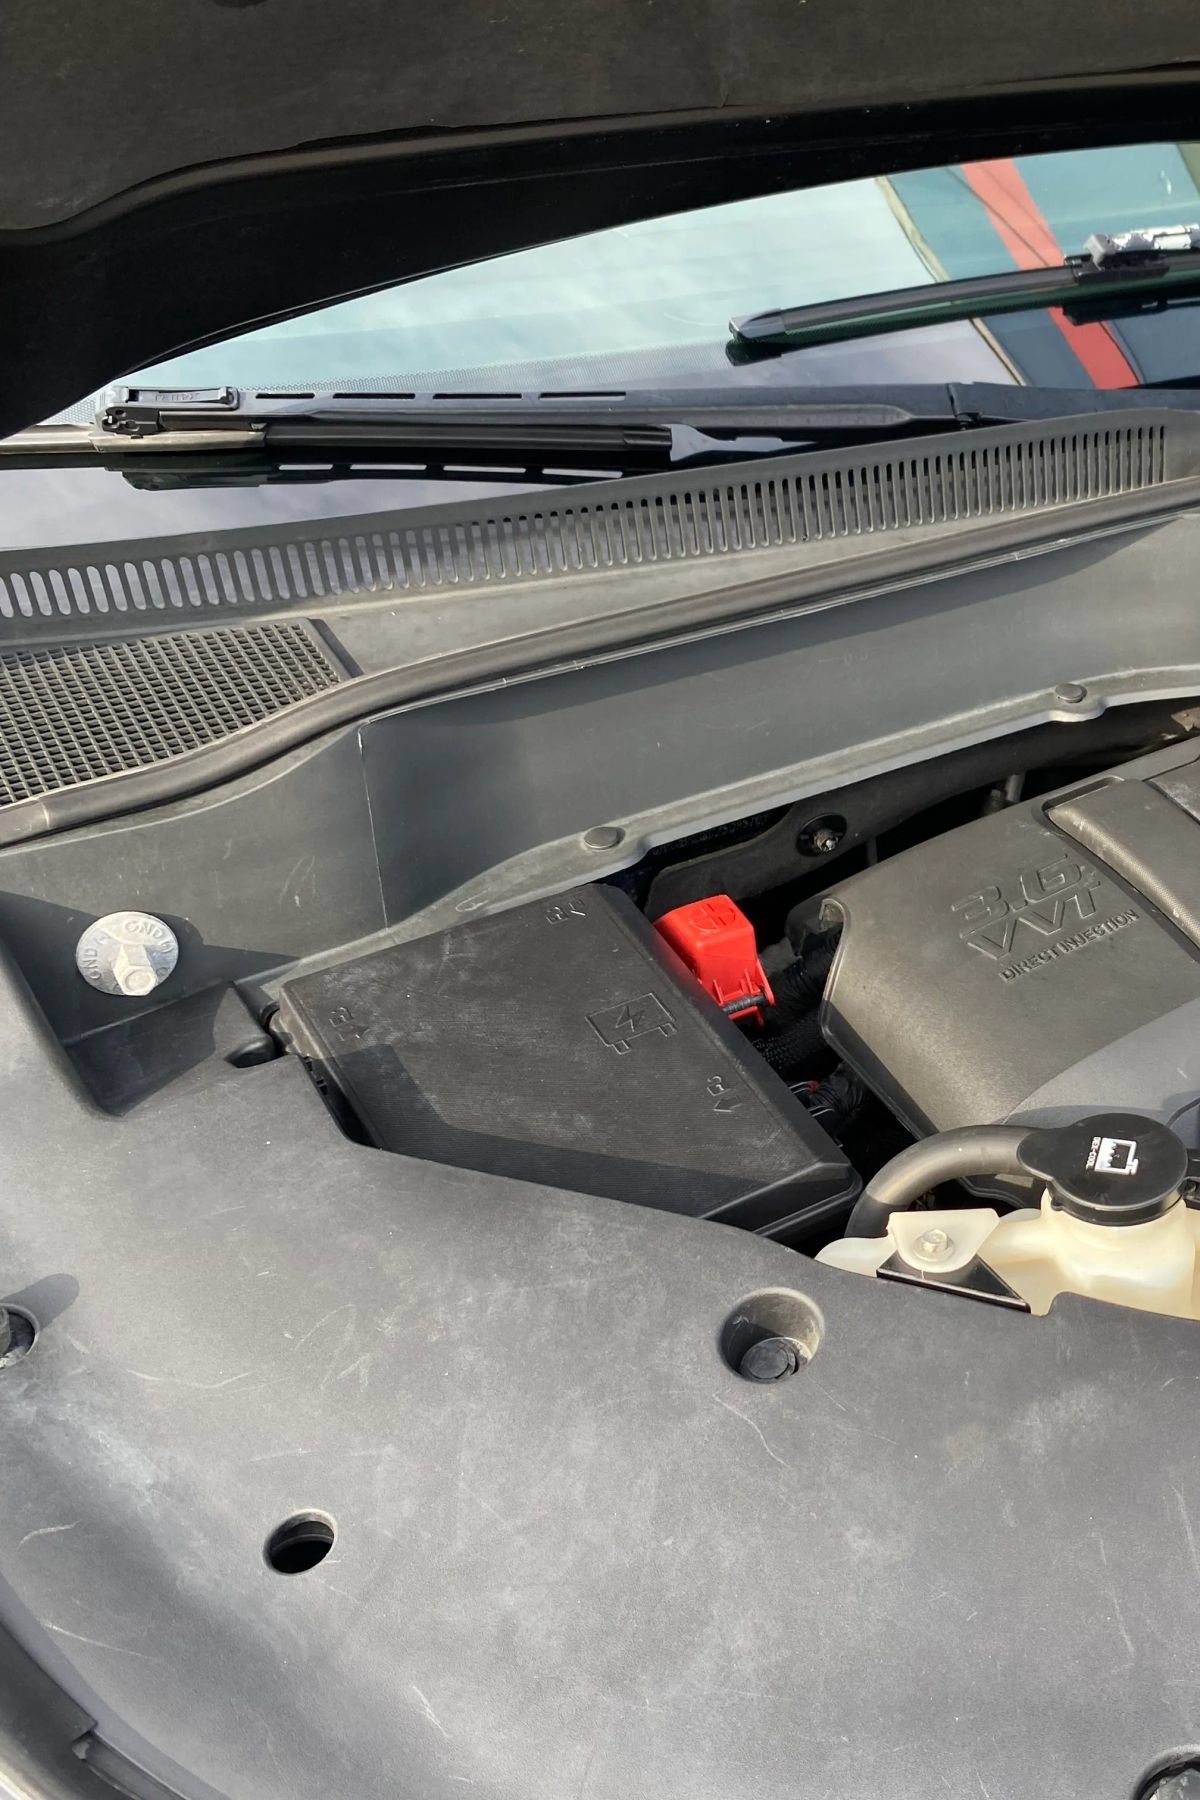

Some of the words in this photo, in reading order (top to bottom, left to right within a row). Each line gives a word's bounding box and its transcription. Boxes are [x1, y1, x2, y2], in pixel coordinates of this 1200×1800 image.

[950, 853, 1084, 940] 3.6
[1000, 949, 1060, 983] DIRECT
[1058, 909, 1140, 953] INJECTION
